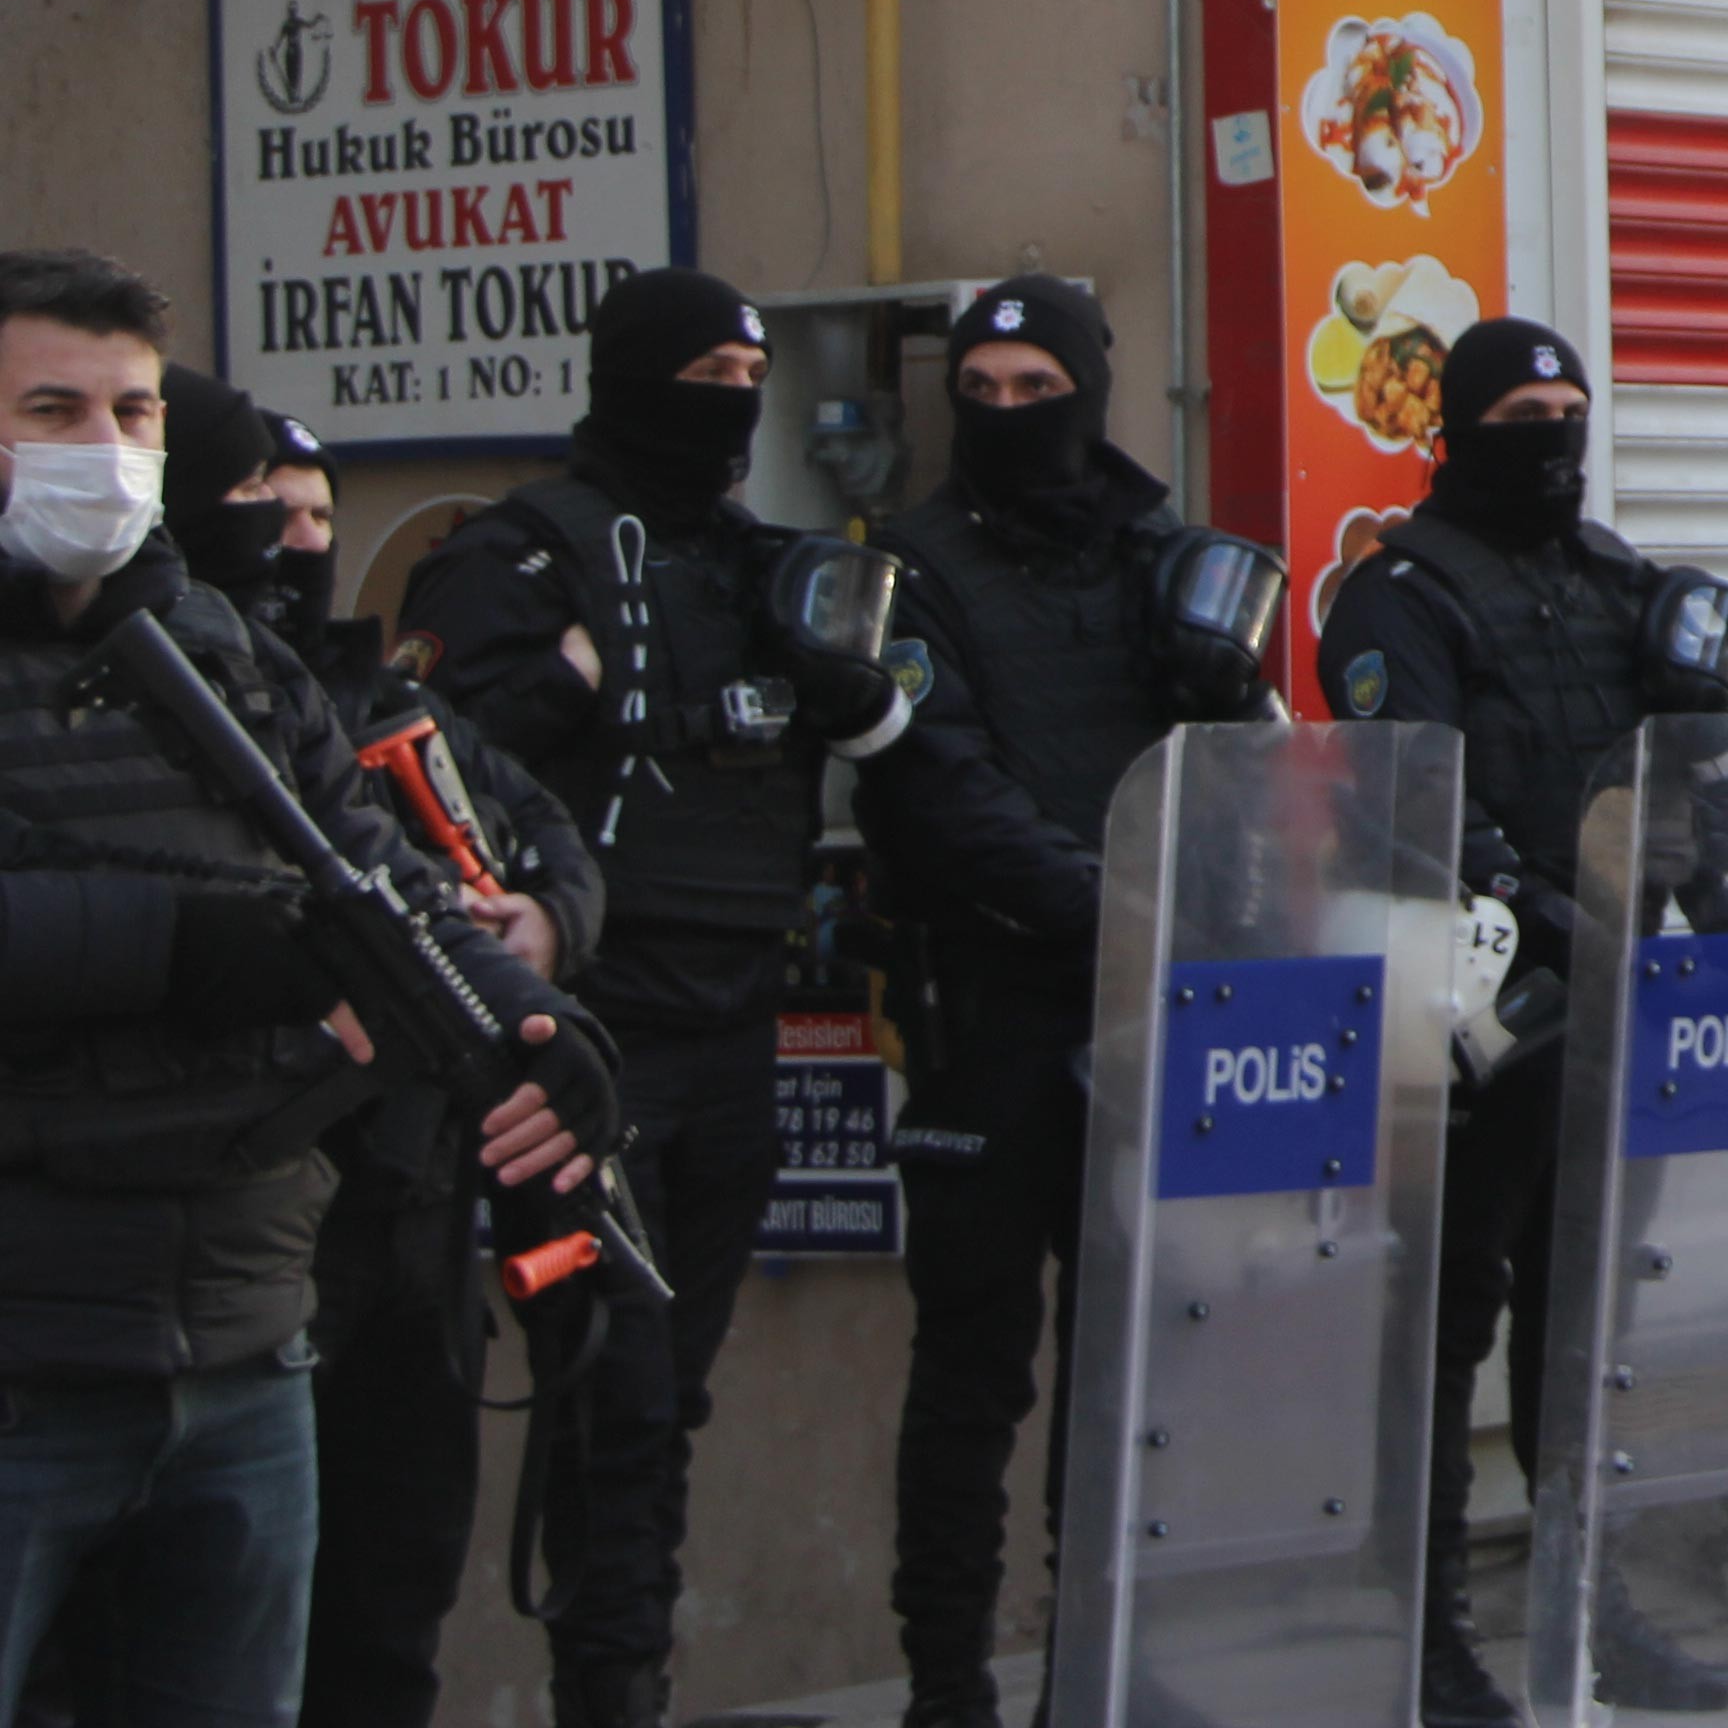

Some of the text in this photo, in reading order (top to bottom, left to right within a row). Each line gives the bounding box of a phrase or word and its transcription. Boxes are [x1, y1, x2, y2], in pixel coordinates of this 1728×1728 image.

[256, 108, 637, 181] Hukuk Bürosu
[322, 177, 574, 257] AVUKAT
[260, 257, 423, 355] İRFAN
[332, 353, 573, 406] KAT: 1 NO: 1
[1472, 921, 1512, 957] 21
[762, 1194, 884, 1233] AYIT BÜROSU
